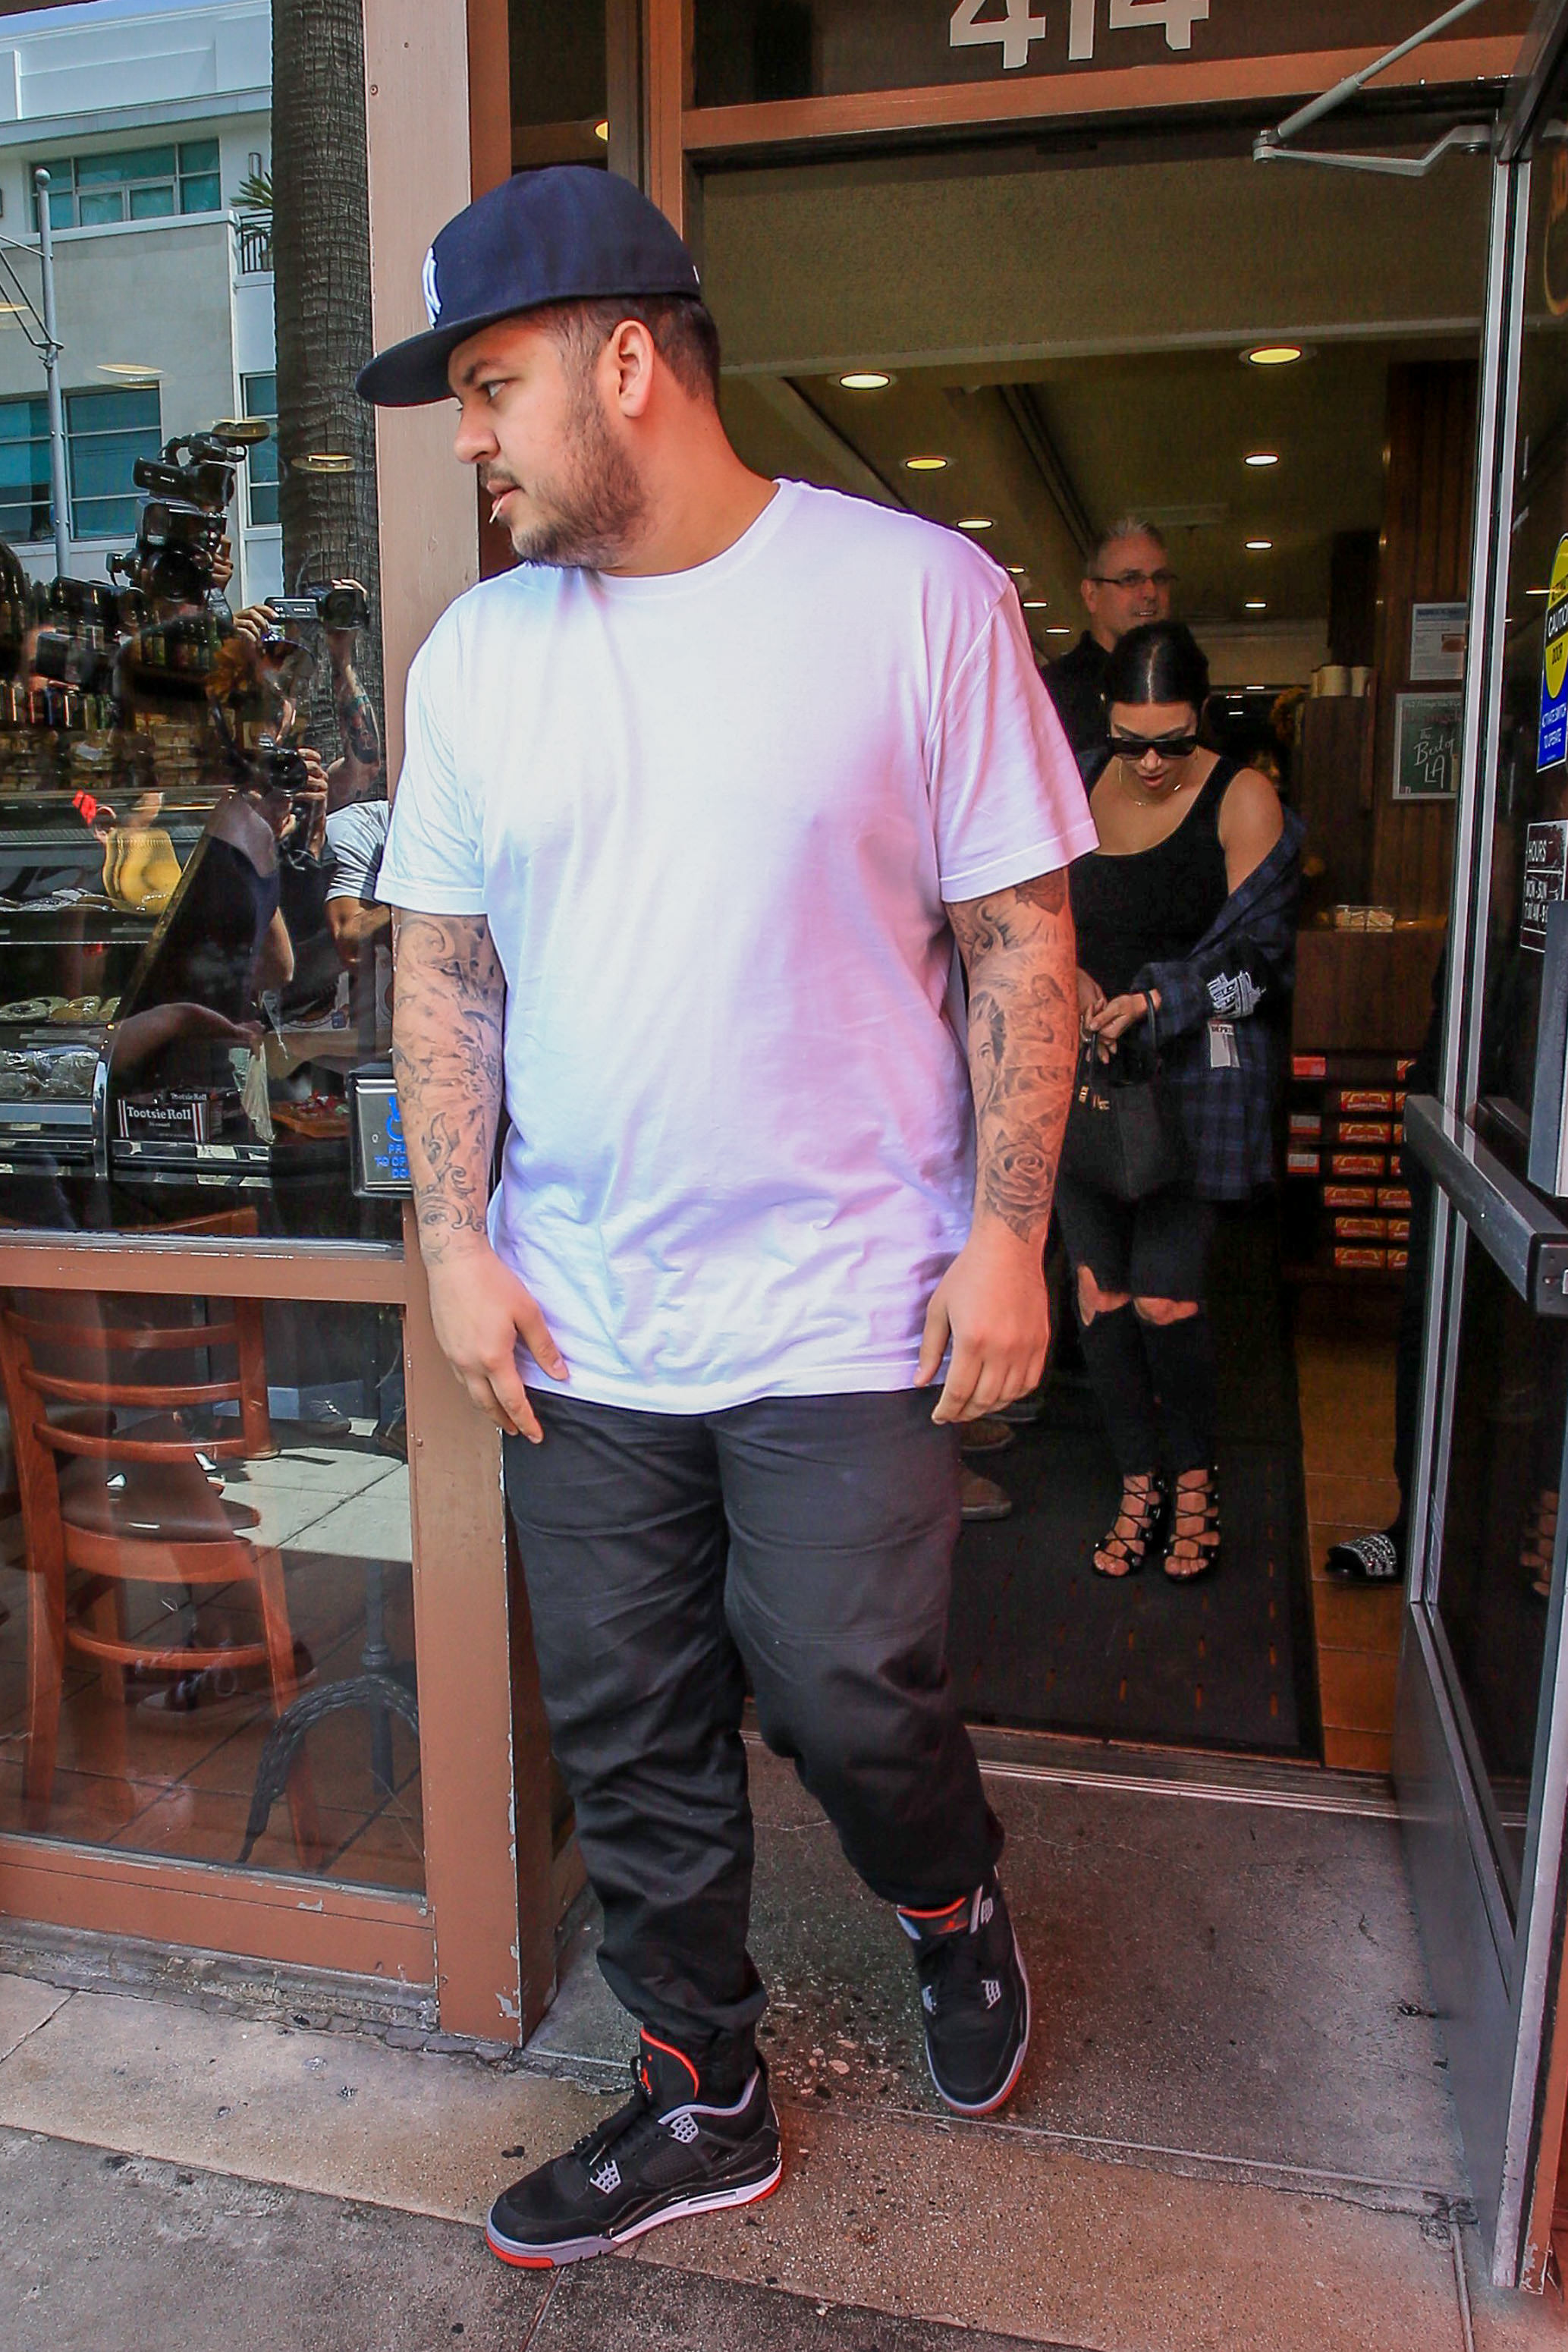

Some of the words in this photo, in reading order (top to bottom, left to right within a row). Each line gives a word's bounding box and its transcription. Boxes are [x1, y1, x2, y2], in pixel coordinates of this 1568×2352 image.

[1425, 754, 1445, 789] LA
[170, 1093, 193, 1101] Tootsie
[127, 1105, 166, 1119] Tootsie
[167, 1108, 193, 1120] Roll
